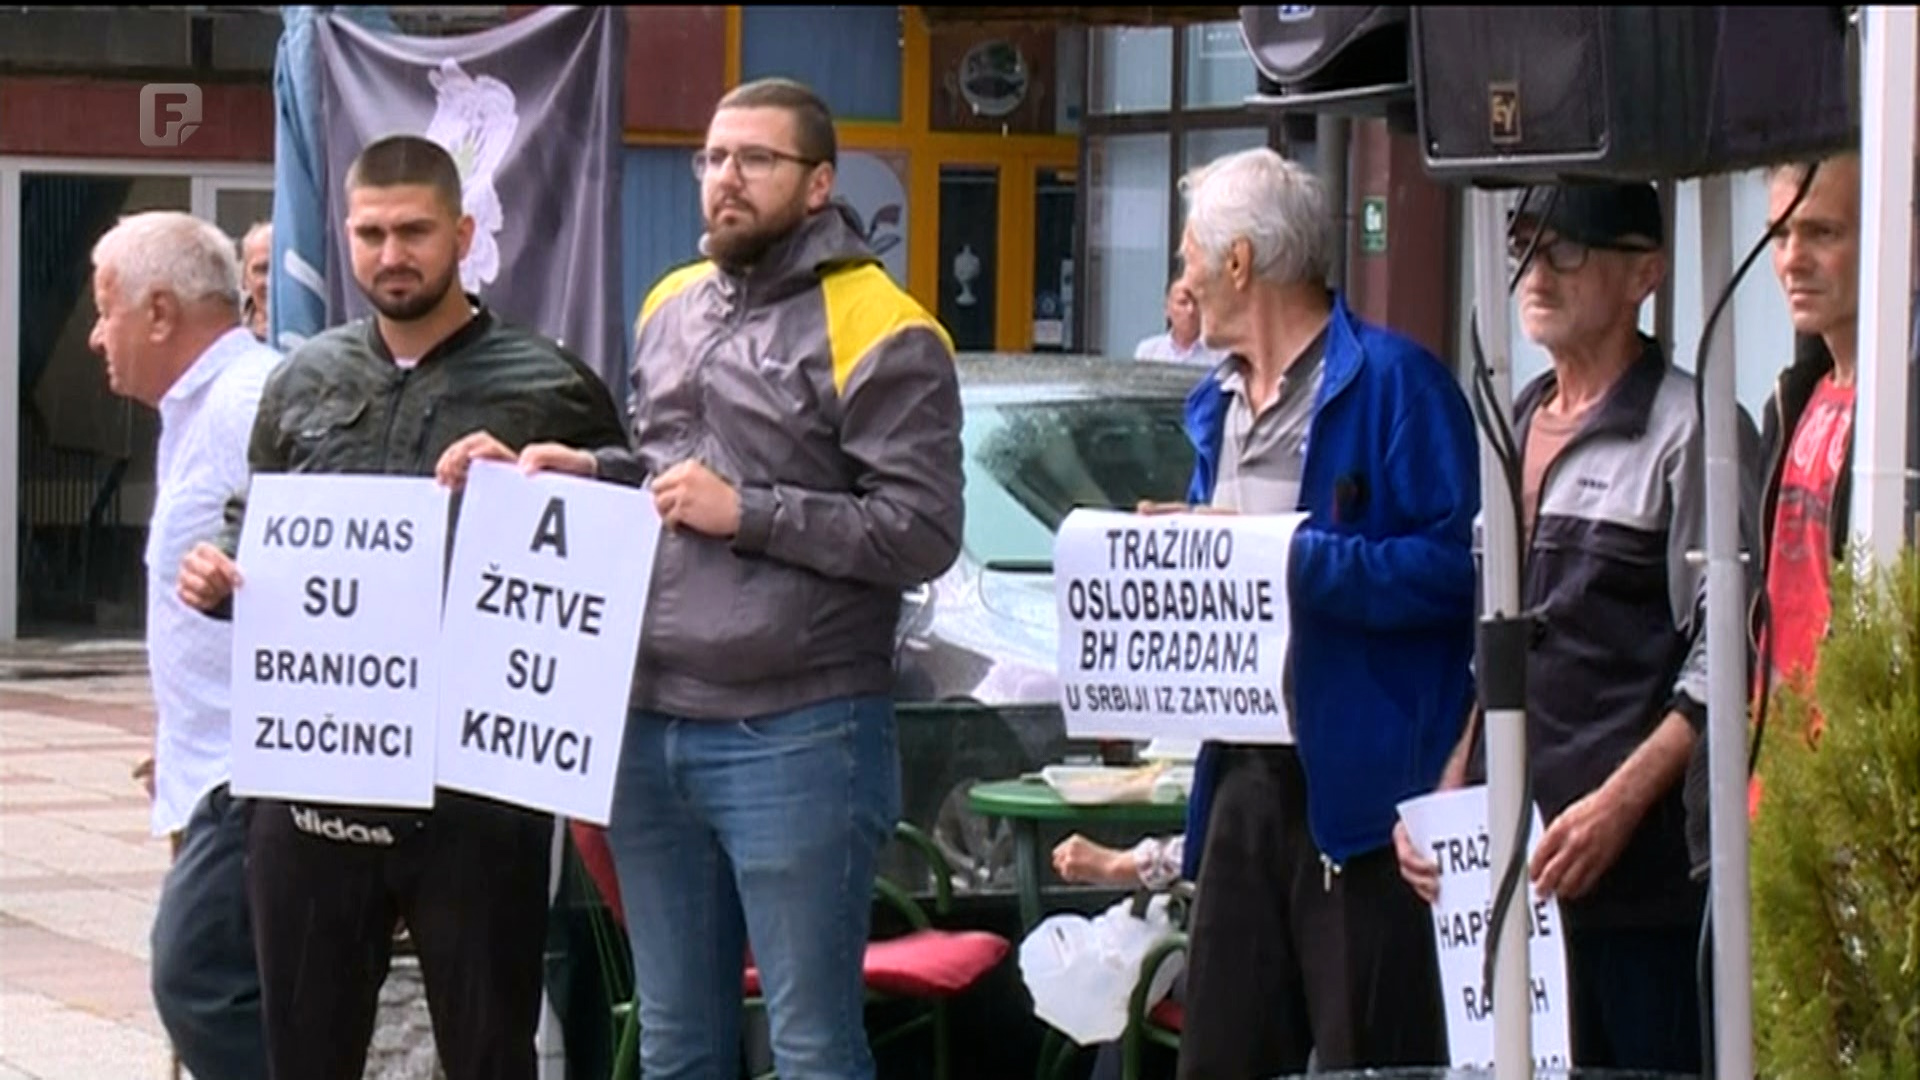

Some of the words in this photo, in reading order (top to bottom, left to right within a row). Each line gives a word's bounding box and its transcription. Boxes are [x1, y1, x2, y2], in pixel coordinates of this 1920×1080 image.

[263, 516, 334, 549] KOD
[344, 517, 415, 552] NAS
[529, 496, 570, 559] A
[1105, 519, 1234, 570] TRAŽIMO
[303, 576, 360, 618] SU
[475, 563, 606, 637] ŽRTVE
[1067, 578, 1275, 622] OSLOBAĐANJE
[254, 648, 419, 690] BRANIOCI
[505, 648, 557, 696] SU
[1080, 629, 1119, 671] BH
[1126, 629, 1259, 673] GRAĐANA
[1065, 683, 1083, 712] U
[1085, 683, 1150, 713] SRBIJI
[1154, 686, 1176, 715] IZ
[1179, 686, 1280, 716] ZATVORA
[254, 714, 414, 758] ZLOČINCI
[460, 709, 593, 776] KRIVCI
